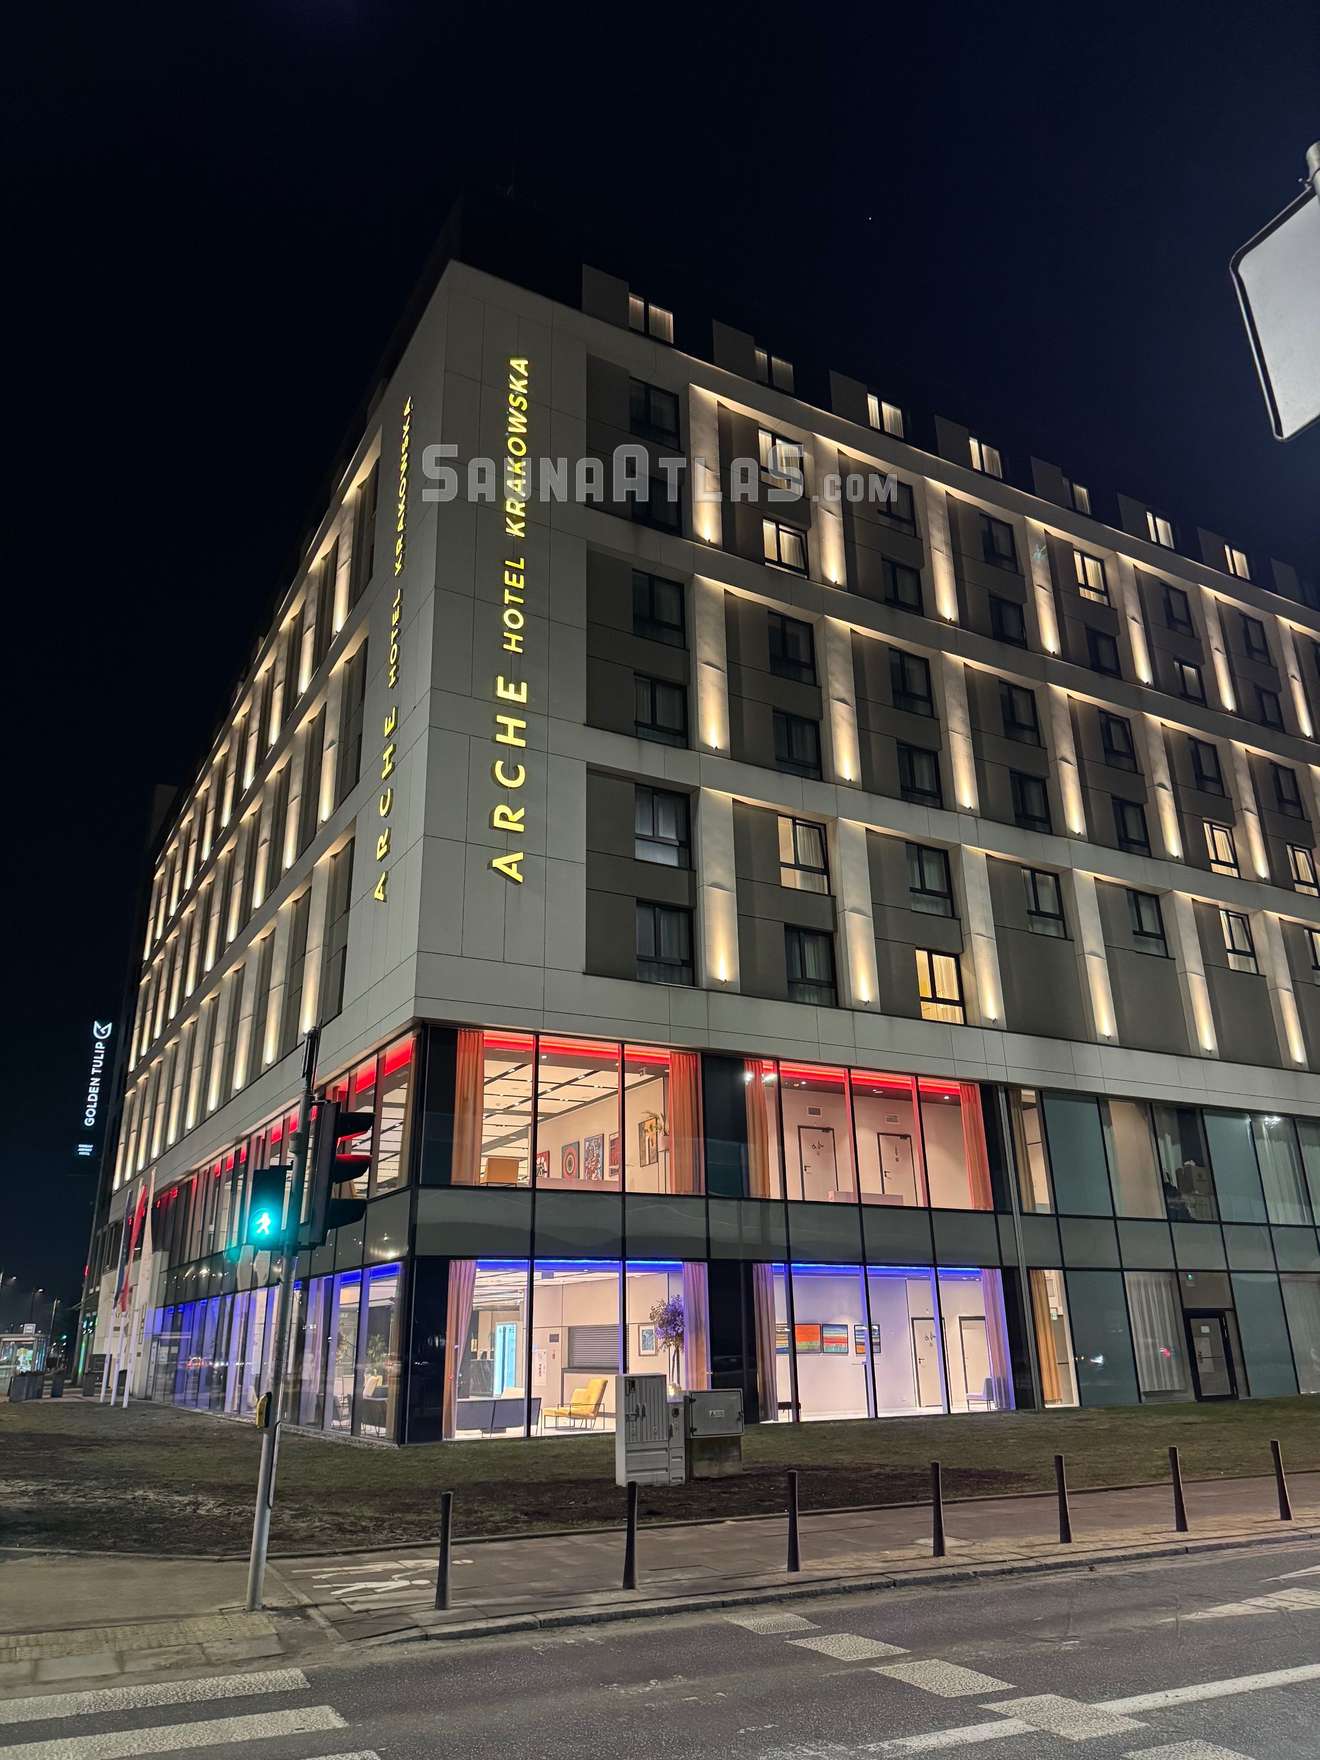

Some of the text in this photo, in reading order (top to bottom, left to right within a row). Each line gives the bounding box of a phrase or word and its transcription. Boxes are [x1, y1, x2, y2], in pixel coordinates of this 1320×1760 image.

[374, 707, 396, 902] ARCHE
[387, 588, 402, 688] HOTEL
[491, 358, 528, 884] ARCHE HOTEL KRAKOWSKA
[84, 1041, 105, 1127] GOLDEN TULIP
